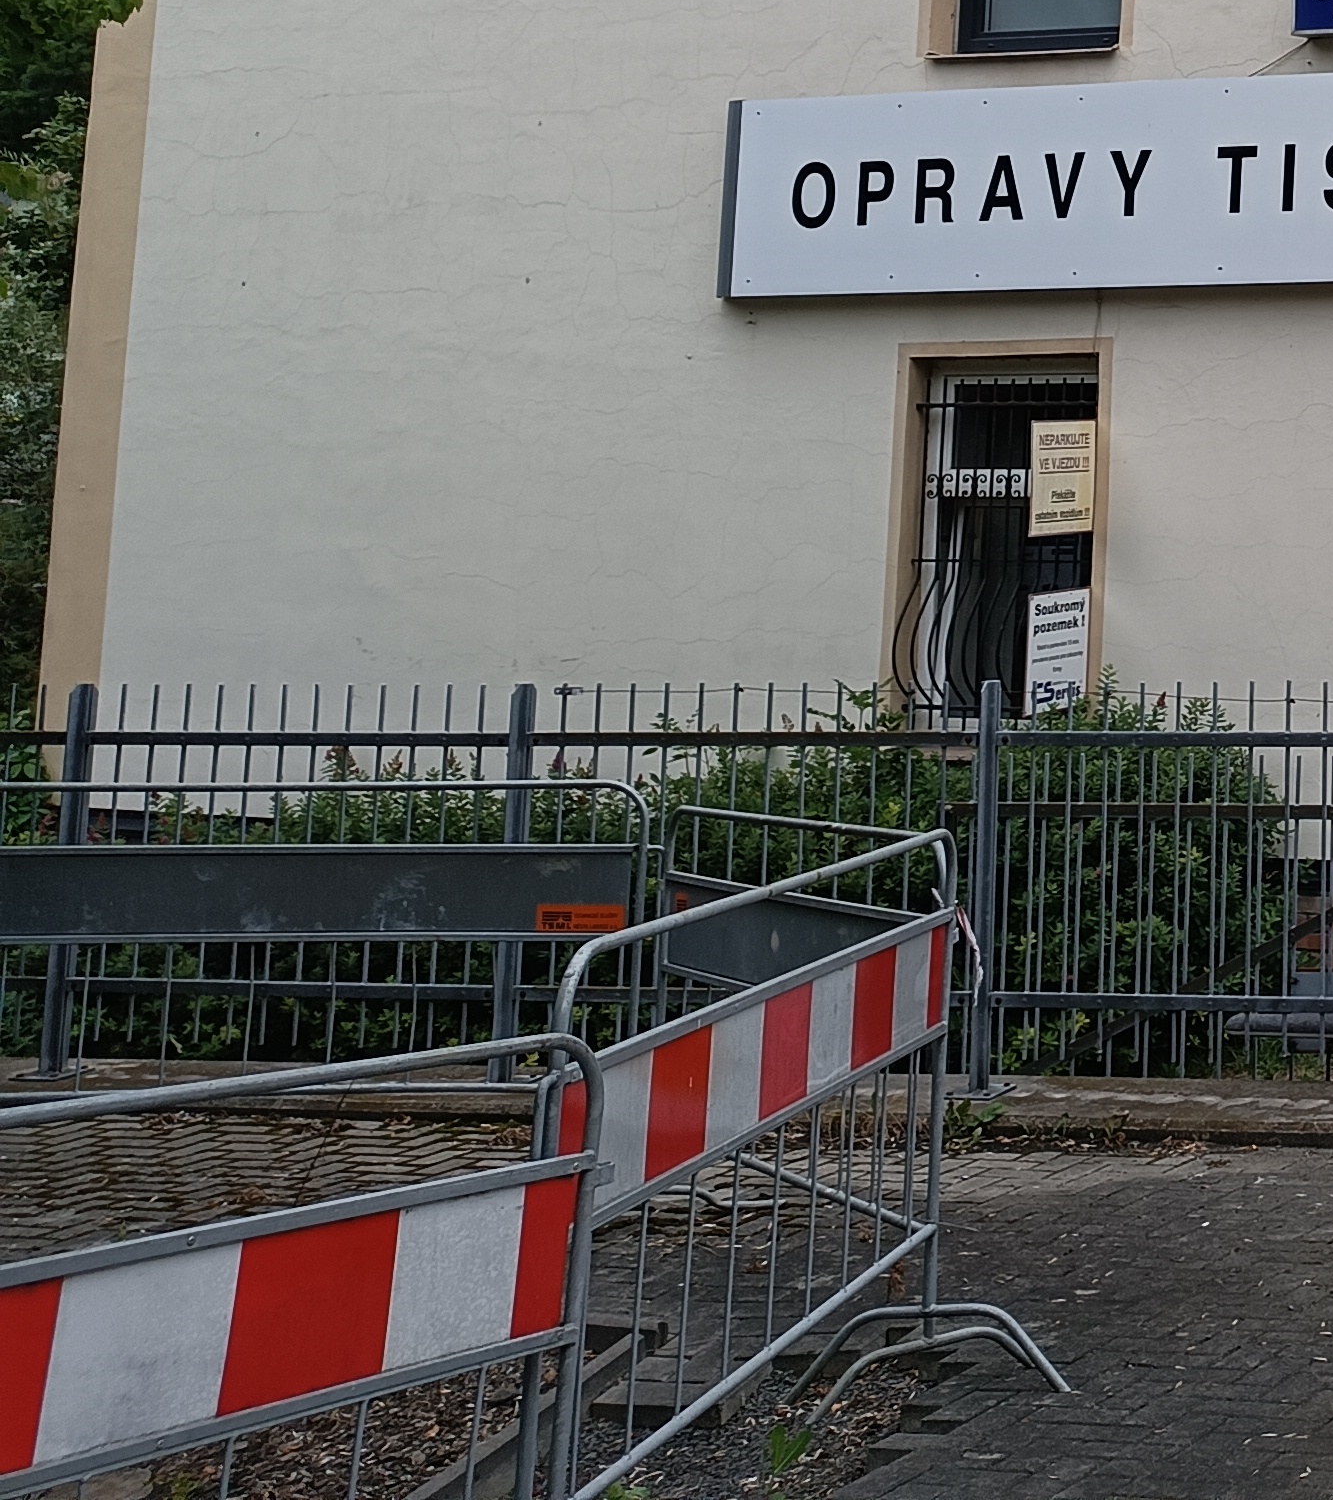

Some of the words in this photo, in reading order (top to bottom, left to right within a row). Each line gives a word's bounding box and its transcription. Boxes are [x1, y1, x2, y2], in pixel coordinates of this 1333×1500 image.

[791, 150, 1153, 229] OPRAVY
[1039, 433, 1090, 446] NEPARKUJTE
[1039, 458, 1050, 470] VE
[1052, 457, 1080, 469] VJEZDU
[1034, 597, 1085, 616] Soukromý
[1033, 616, 1079, 637] pozemek
